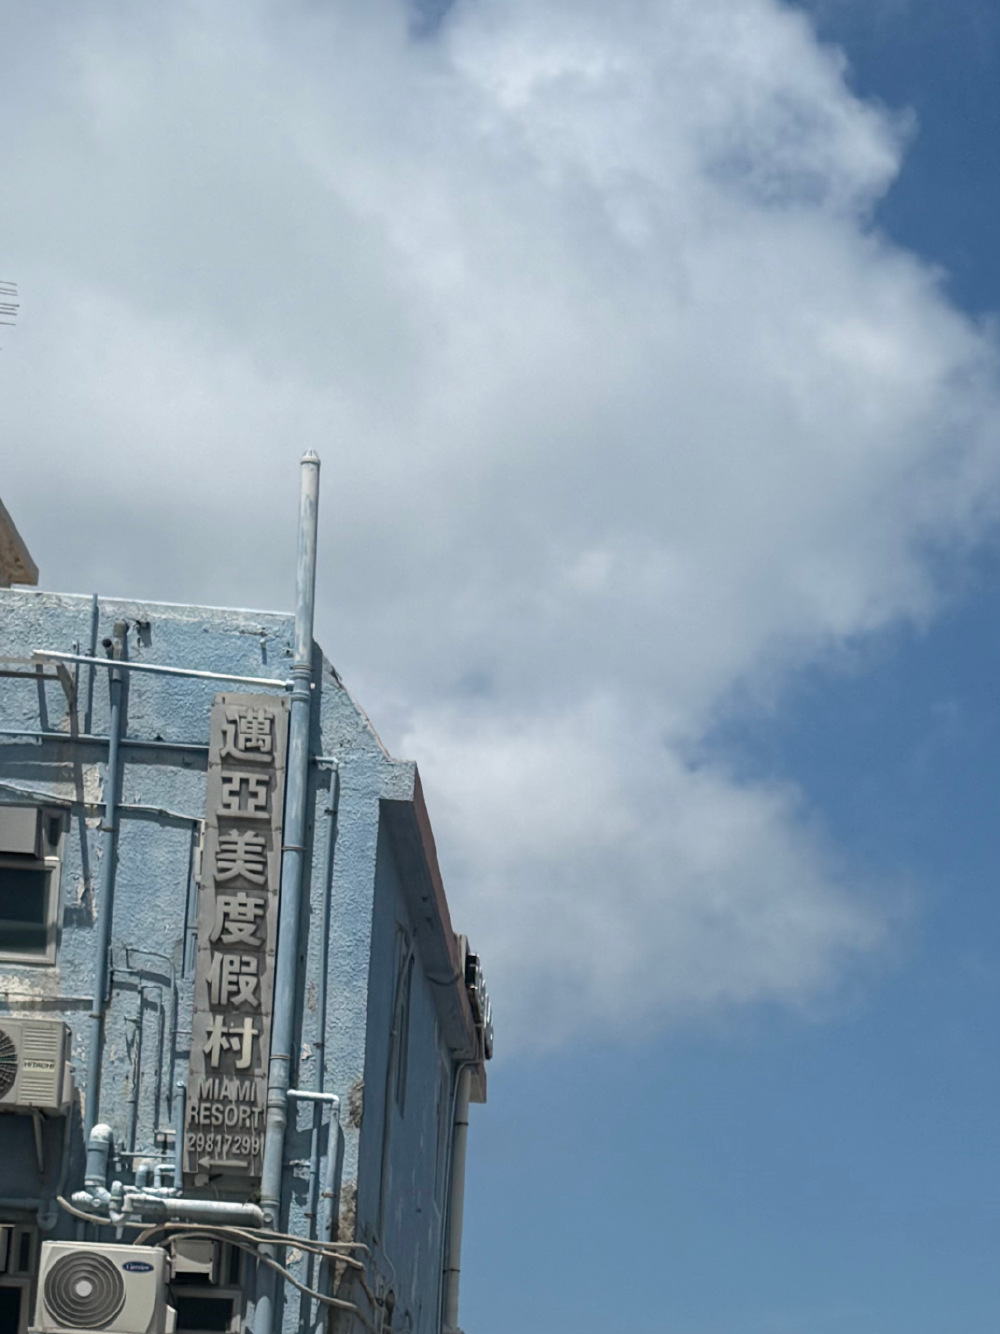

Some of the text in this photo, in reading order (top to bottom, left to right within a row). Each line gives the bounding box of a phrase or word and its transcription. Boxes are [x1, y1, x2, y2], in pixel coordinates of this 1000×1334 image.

[203, 709, 275, 1070] 邁亞美度假村
[198, 1078, 258, 1102] MIAMI
[188, 1103, 265, 1129] RESORT
[187, 1132, 260, 1155] 29817299
[125, 1263, 152, 1272] Carrier
